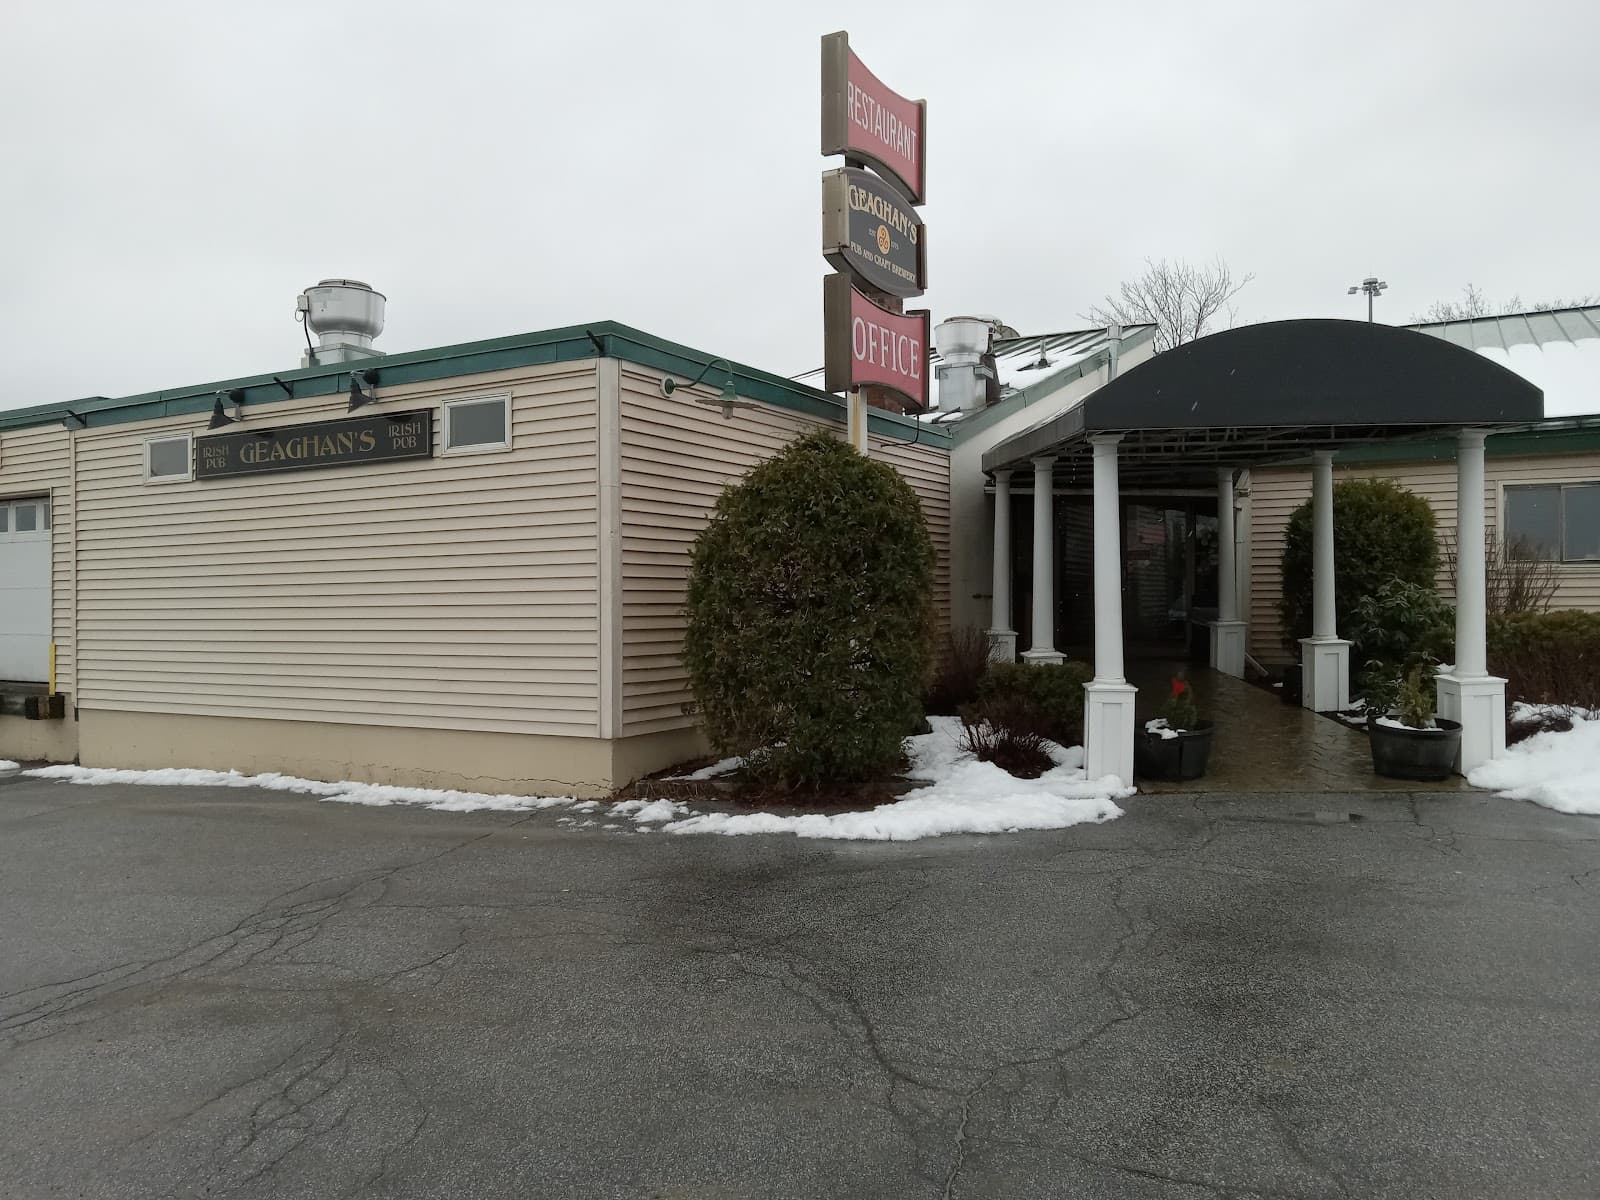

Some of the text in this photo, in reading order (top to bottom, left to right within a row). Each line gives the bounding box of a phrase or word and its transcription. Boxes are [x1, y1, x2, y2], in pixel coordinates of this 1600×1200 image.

[847, 80, 917, 165] RESTAURANT
[848, 184, 918, 245] GEAGHAN'S
[850, 241, 916, 283] PUB AND CRAFT BREWERY
[852, 316, 920, 380] OFFICE
[239, 429, 377, 464] GEAGHAN'S
[388, 421, 421, 438] IRISH
[393, 433, 417, 450] PUB
[203, 444, 229, 458] IRISH
[206, 457, 226, 469] PUB
